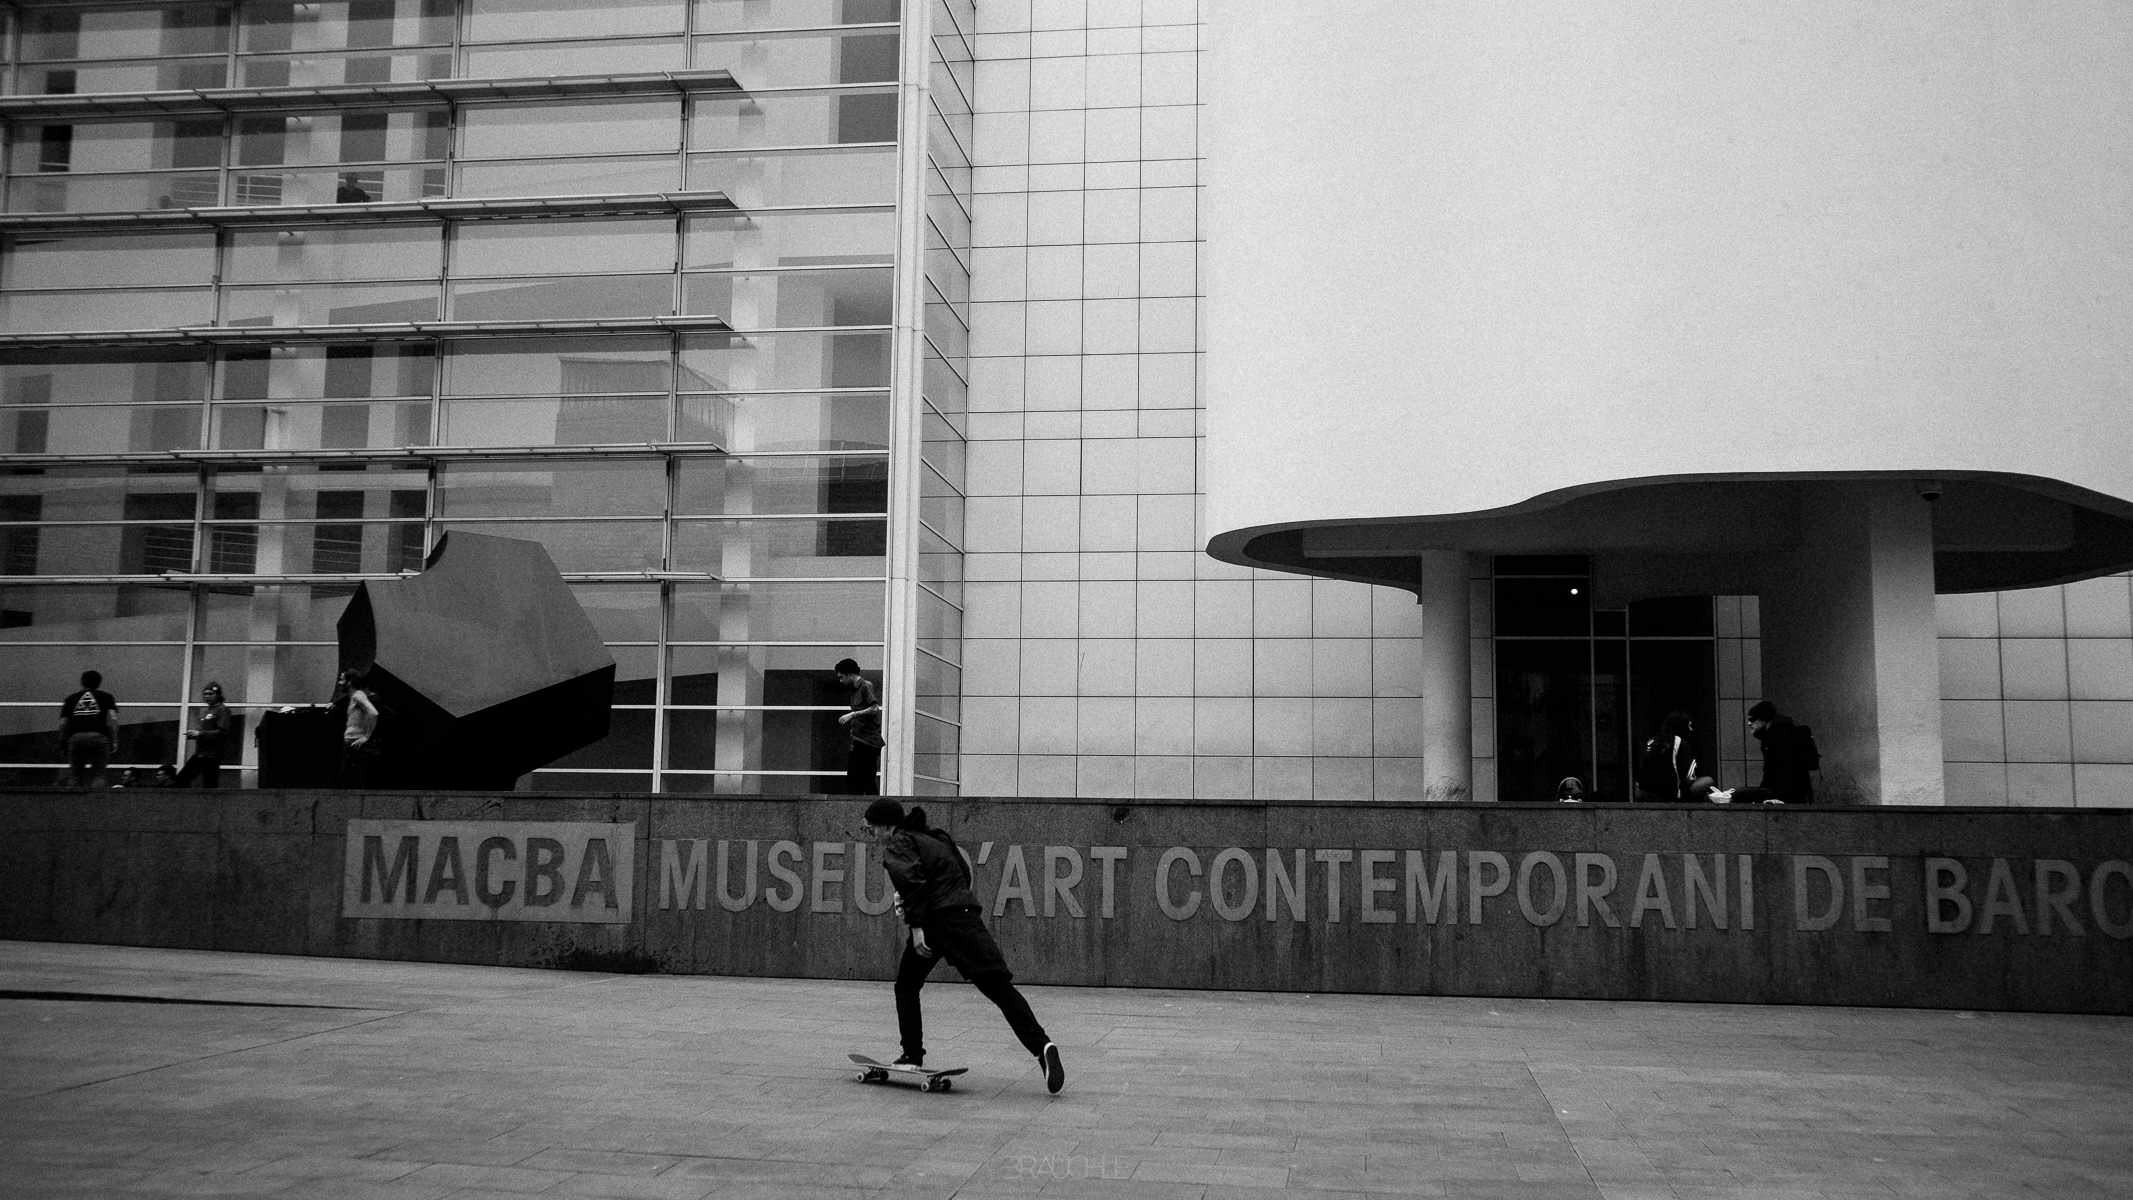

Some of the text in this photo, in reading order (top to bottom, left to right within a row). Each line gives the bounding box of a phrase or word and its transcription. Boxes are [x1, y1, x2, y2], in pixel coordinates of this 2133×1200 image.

[360, 835, 620, 913] MACBA
[658, 838, 896, 916] MUSEU
[956, 841, 1128, 919] 'ART
[1155, 845, 1755, 932] CONTEMPORANI
[1795, 854, 1893, 932] DE
